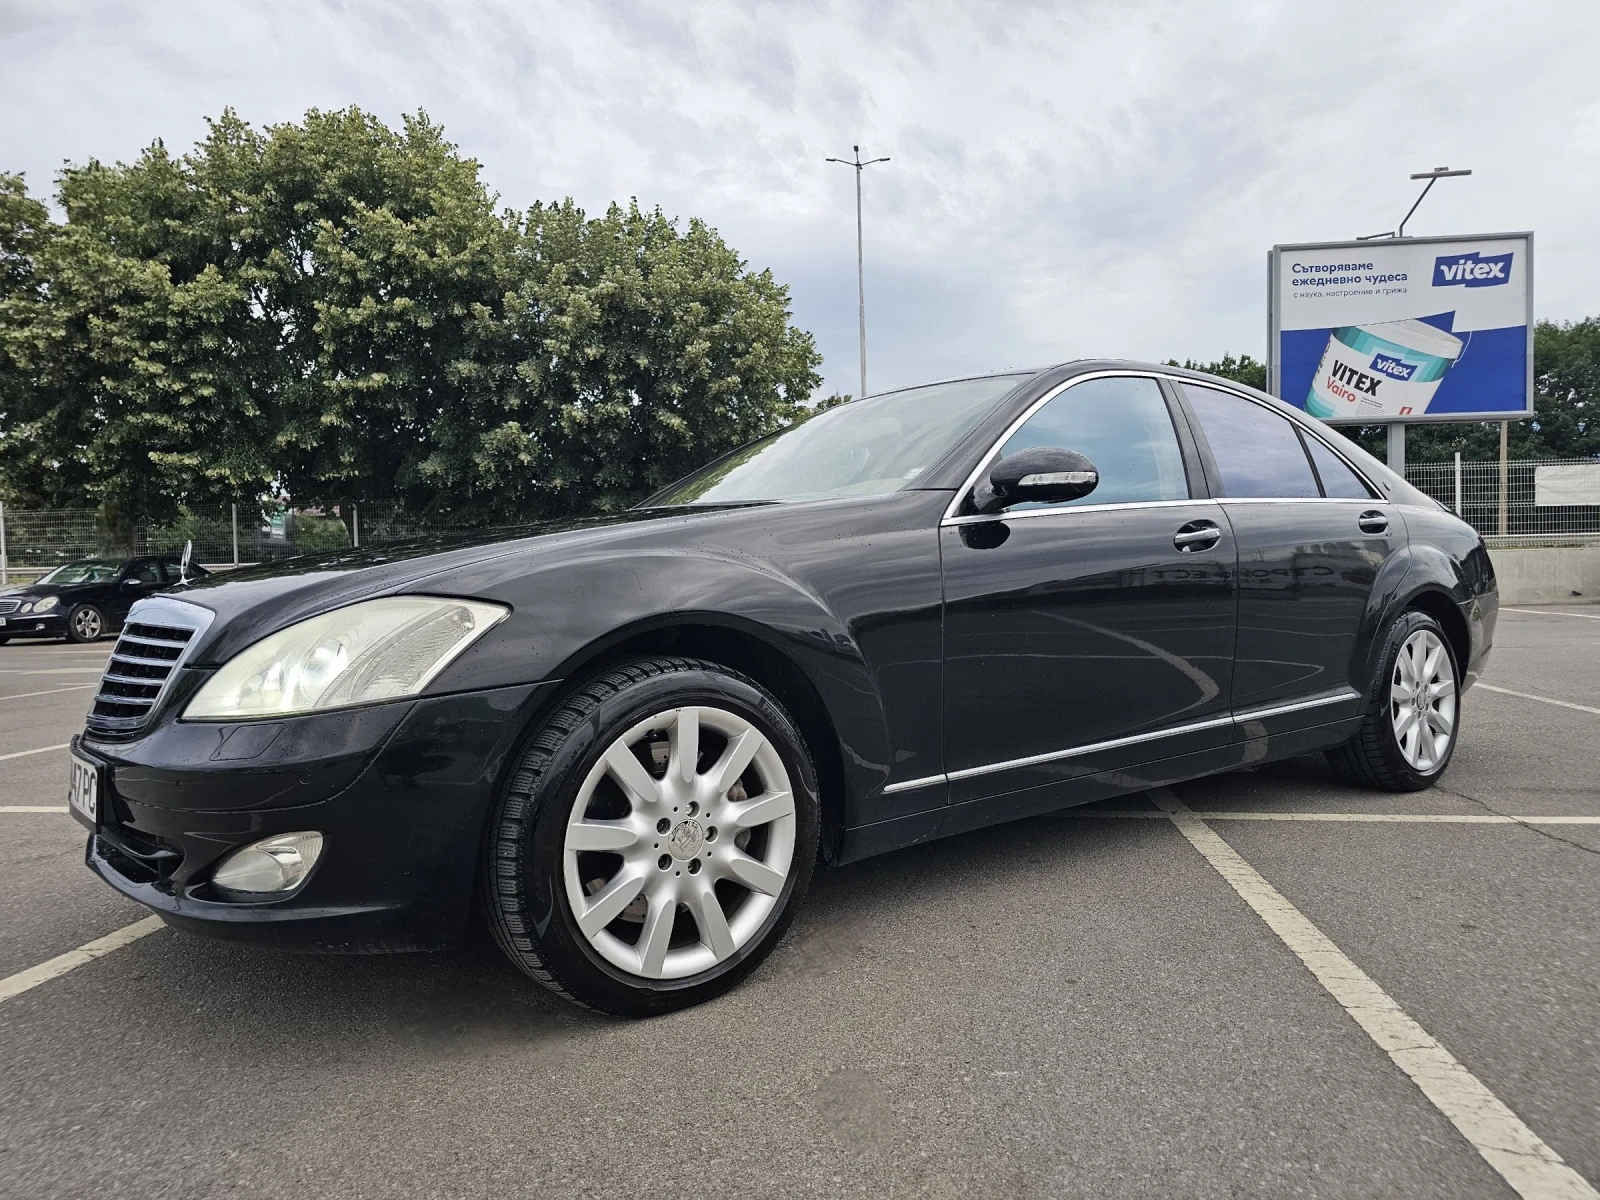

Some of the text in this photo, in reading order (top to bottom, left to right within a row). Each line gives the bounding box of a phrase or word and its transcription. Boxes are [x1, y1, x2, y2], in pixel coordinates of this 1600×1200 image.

[1291, 262, 1374, 275] Сътворяваме
[1440, 259, 1505, 281] vitex
[1291, 273, 1408, 287] ежедневно чудеса
[1299, 290, 1325, 299] наука,
[1325, 288, 1374, 298] настроение
[1382, 286, 1408, 296] грижа
[1331, 359, 1383, 397] VITEX
[1376, 359, 1412, 378] vitex
[1326, 375, 1357, 402] Vairo
